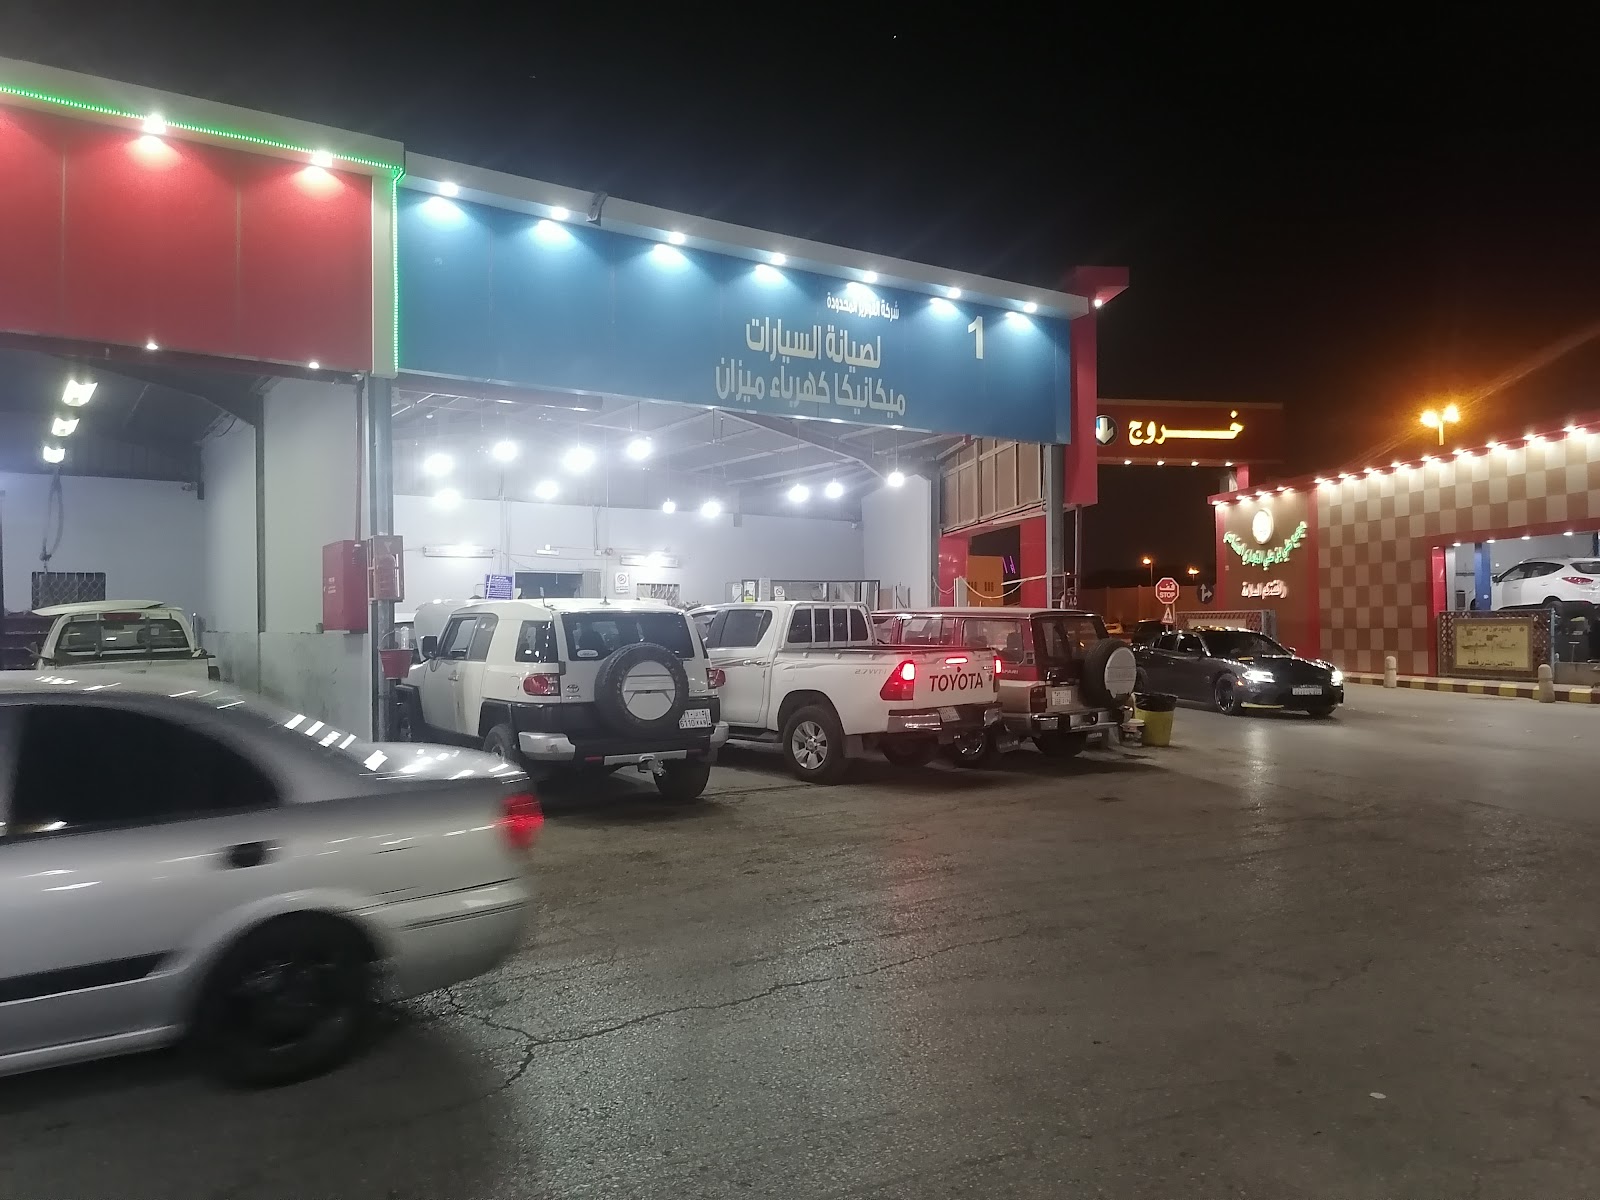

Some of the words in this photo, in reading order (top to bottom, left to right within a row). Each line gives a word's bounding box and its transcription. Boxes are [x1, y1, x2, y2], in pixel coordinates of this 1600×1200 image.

[881, 298, 900, 322] شركة
[745, 316, 822, 364] السيارات
[825, 324, 881, 373] لصيانة
[967, 315, 984, 360] 1
[715, 357, 766, 402] ميزان
[769, 362, 830, 408] كهرباء
[834, 371, 906, 418] ميكانيكا
[1128, 410, 1245, 446] خروج
[1159, 581, 1176, 591] قف
[929, 673, 983, 692] TOYOTA
